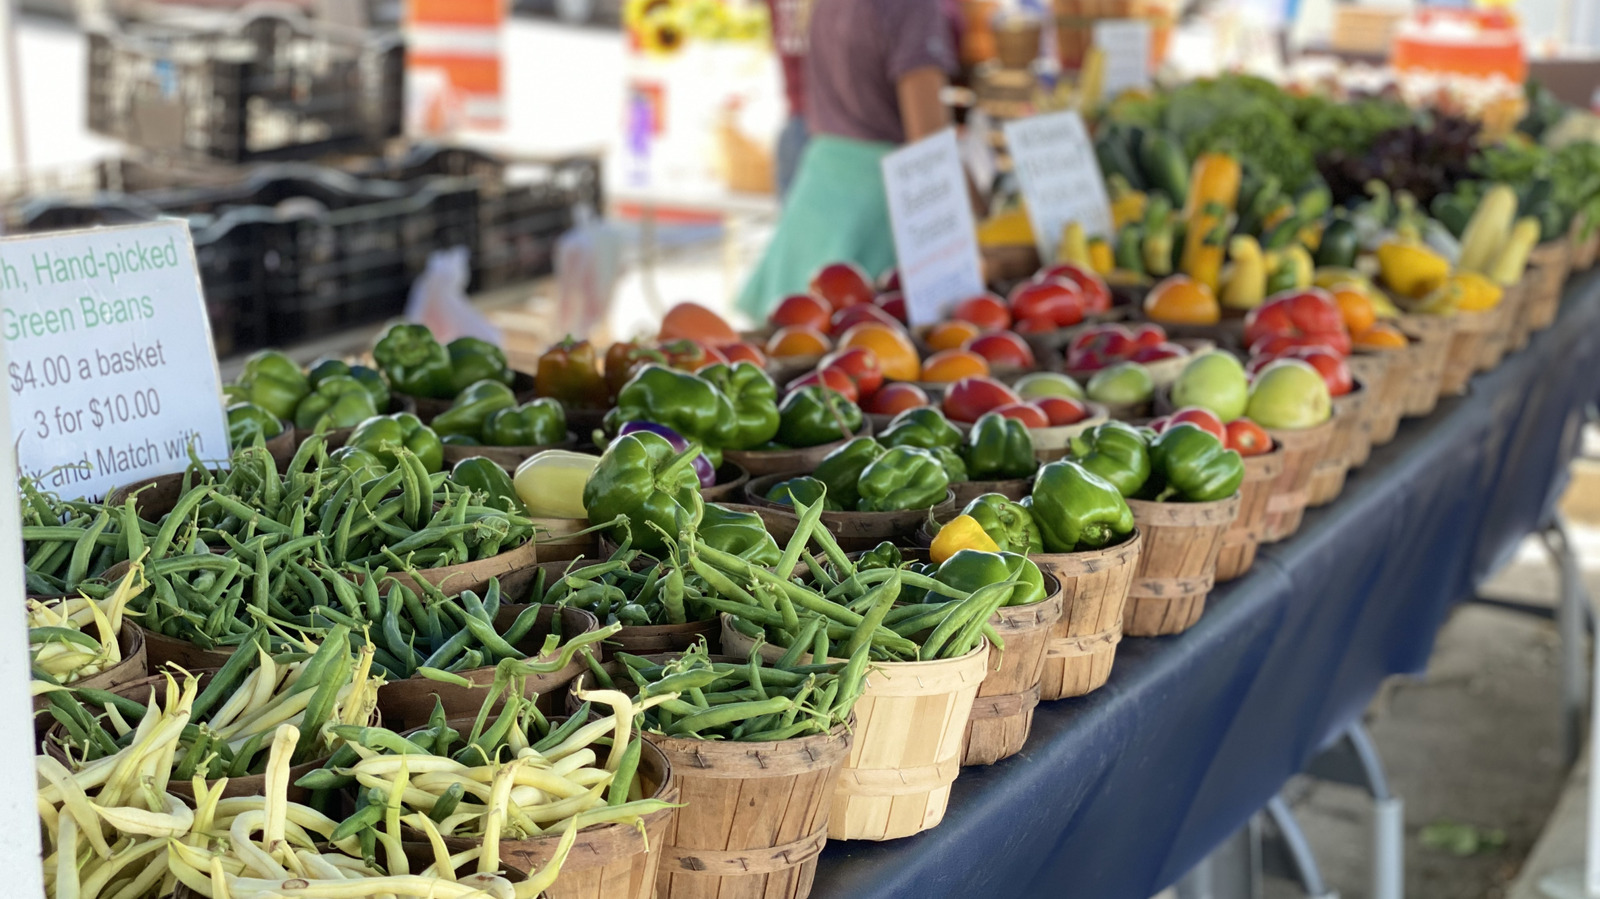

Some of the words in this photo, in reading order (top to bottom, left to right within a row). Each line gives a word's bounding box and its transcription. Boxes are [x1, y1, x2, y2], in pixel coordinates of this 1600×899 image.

[32, 236, 179, 285] Hand-picked
[3, 306, 76, 341] Green
[79, 295, 155, 329] Beans
[8, 354, 72, 396] $4.00
[77, 358, 92, 381] a
[96, 339, 166, 377] basket
[34, 409, 50, 440] 3
[54, 405, 83, 436] for
[89, 387, 161, 429] $10.00
[52, 451, 92, 488] and
[96, 437, 160, 477] Match
[163, 428, 204, 461] with
